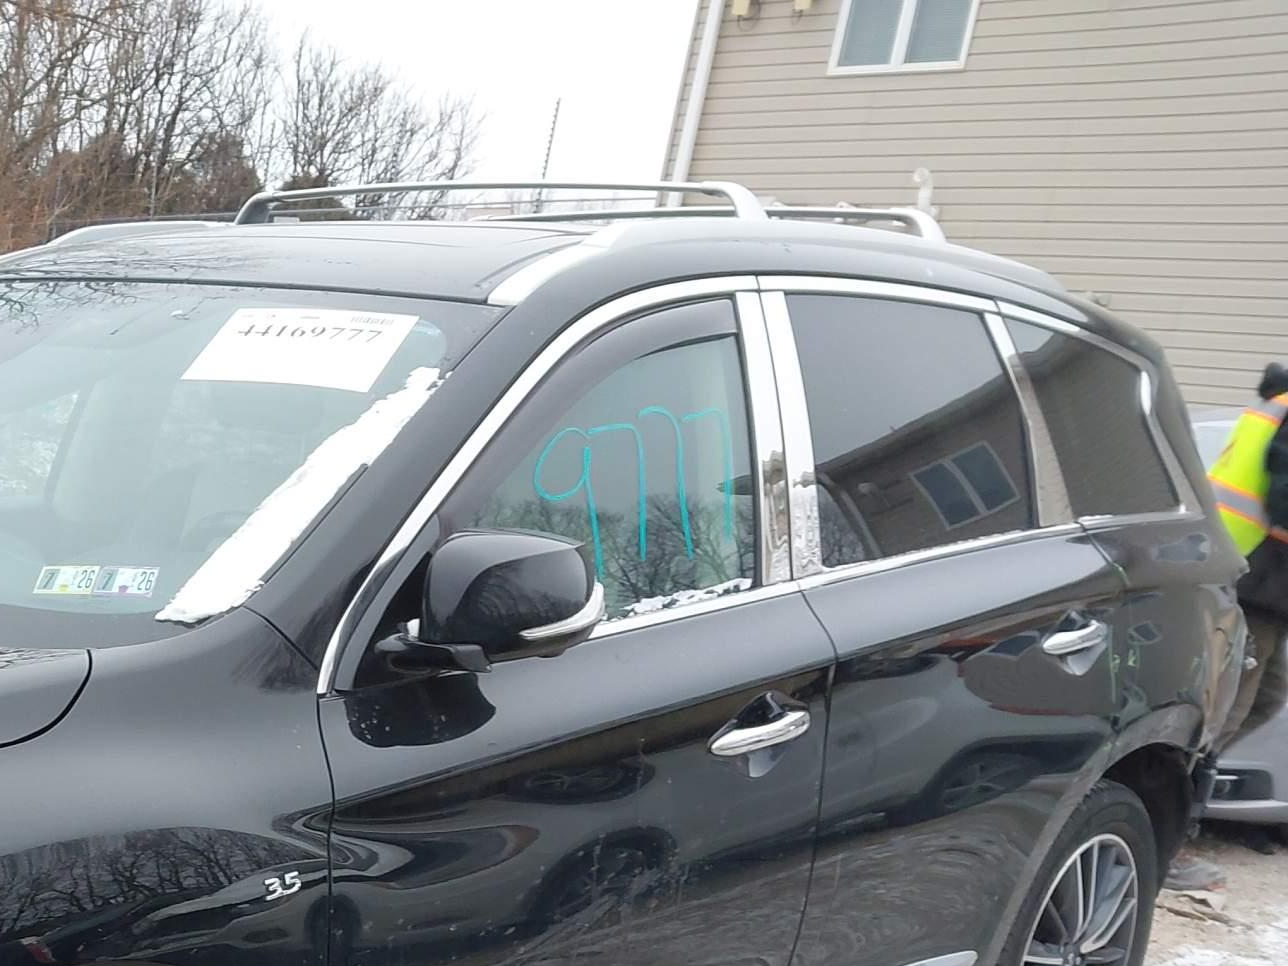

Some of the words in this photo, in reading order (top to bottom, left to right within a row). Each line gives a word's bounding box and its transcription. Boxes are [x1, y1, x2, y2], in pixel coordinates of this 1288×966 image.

[237, 323, 384, 344] 44169777
[43, 571, 57, 590] 7
[77, 569, 96, 590] 26
[102, 572, 114, 592] 7
[137, 571, 156, 592] 26
